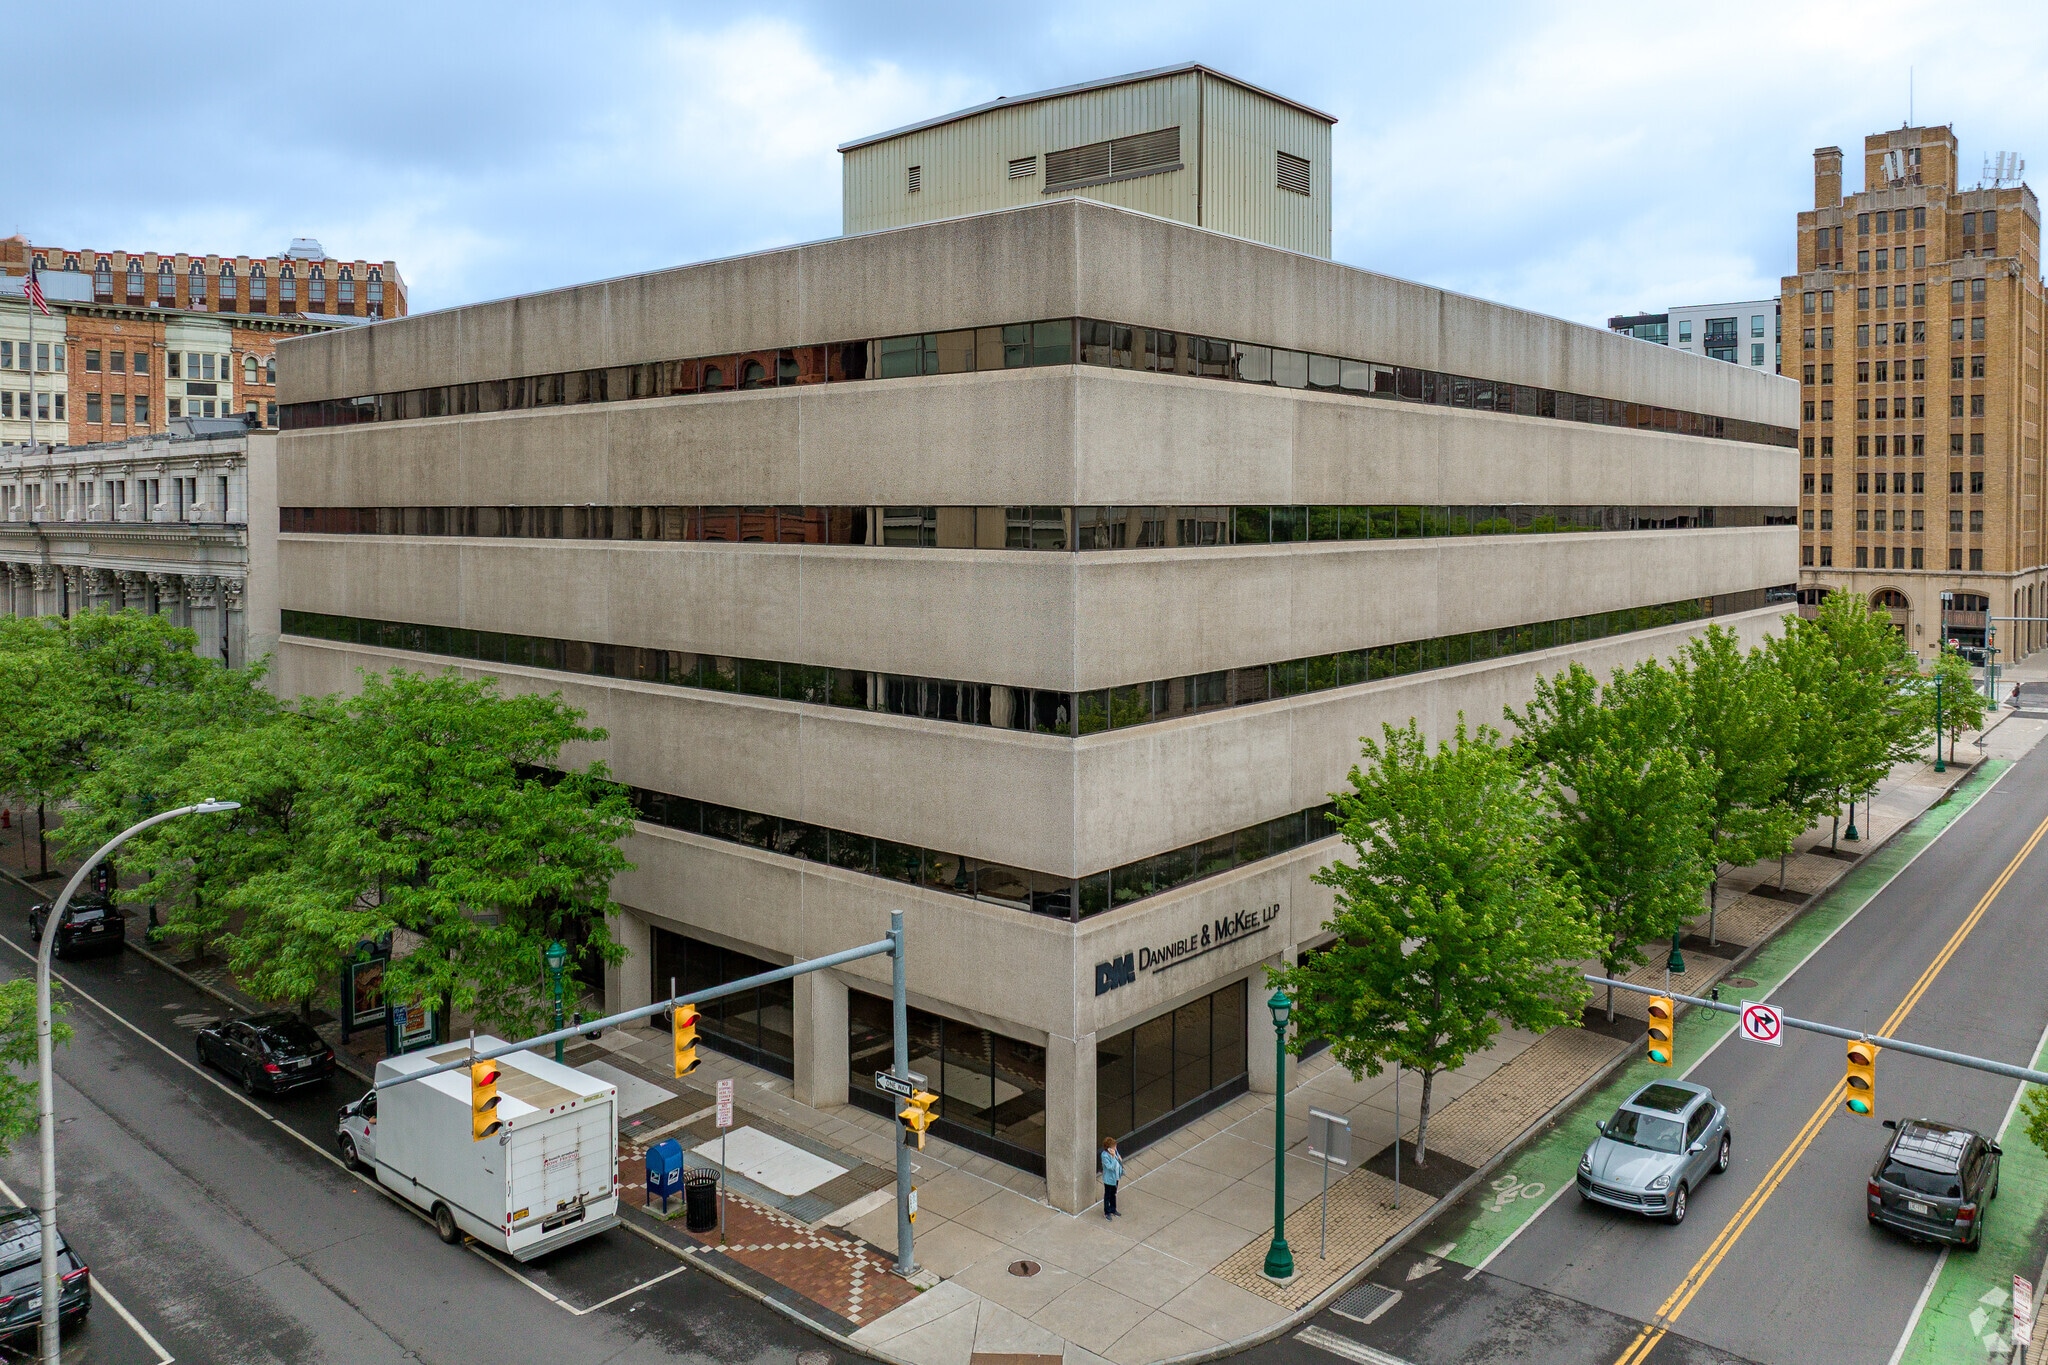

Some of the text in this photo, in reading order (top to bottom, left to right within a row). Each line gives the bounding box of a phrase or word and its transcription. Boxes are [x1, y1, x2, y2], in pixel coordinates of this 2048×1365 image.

[1139, 934, 1198, 971] DANNIBLE
[1201, 924, 1211, 946] &
[1263, 903, 1280, 922] LLP
[886, 1080, 896, 1088] ONE
